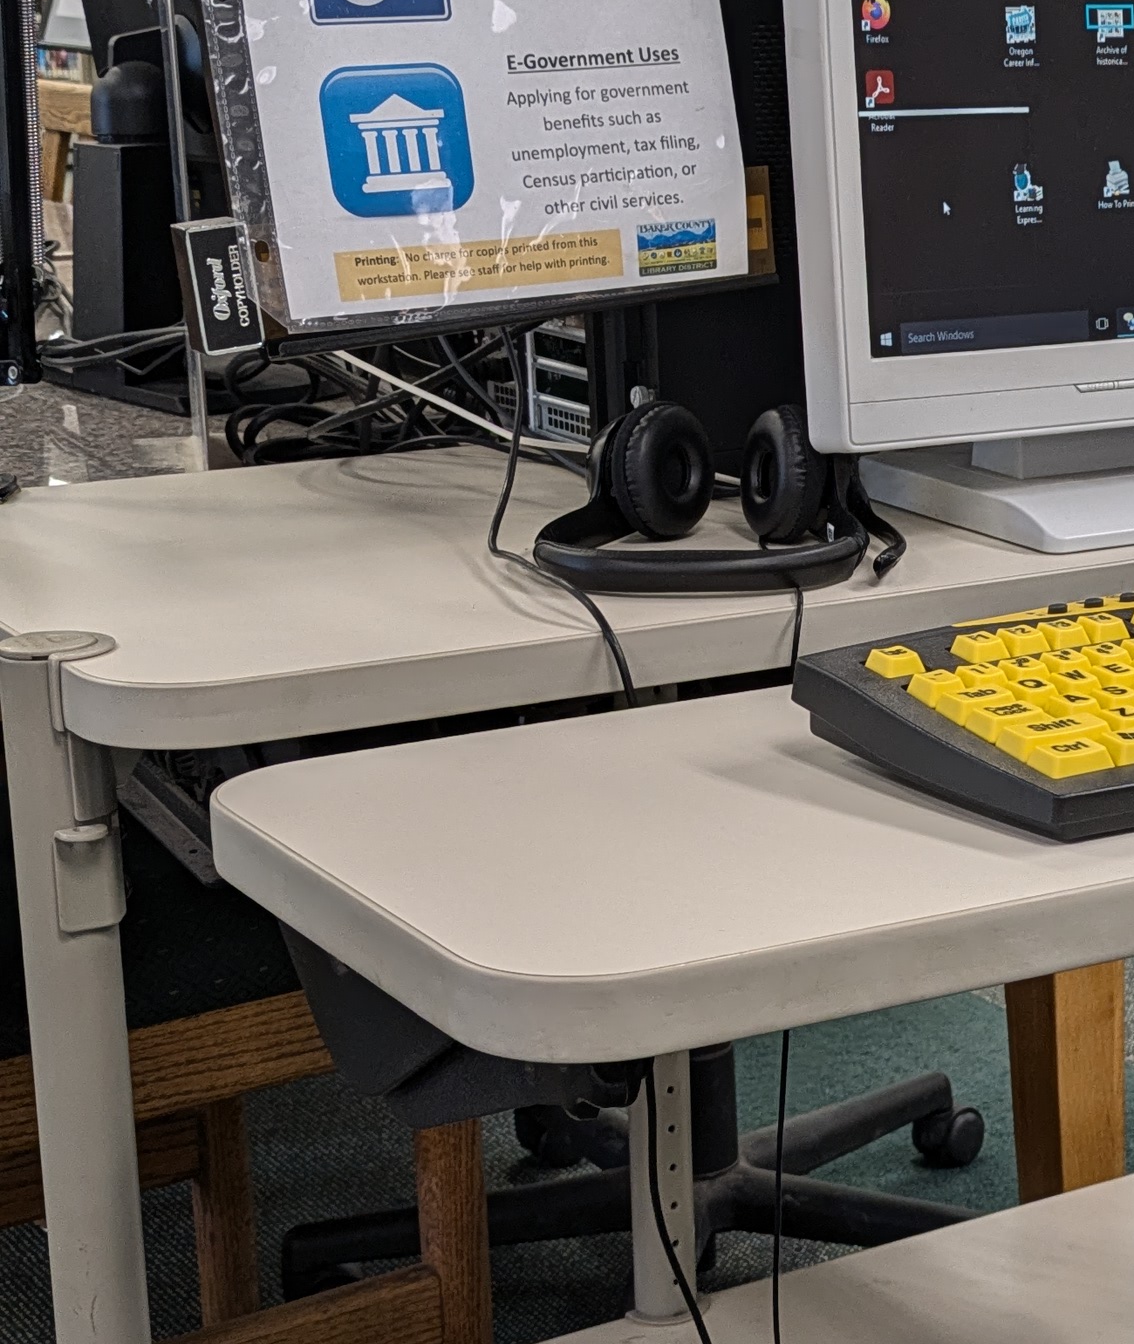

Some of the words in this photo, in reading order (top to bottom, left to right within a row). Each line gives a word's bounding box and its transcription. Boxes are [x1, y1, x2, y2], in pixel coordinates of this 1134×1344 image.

[865, 34, 889, 44] Firefox
[1008, 46, 1033, 57] Oregon
[1096, 45, 1120, 55] Archive
[1120, 44, 1128, 54] of
[506, 48, 634, 71] E-Government
[638, 46, 680, 63] Uses
[1003, 57, 1025, 68] Career
[506, 88, 572, 109] Applying
[575, 86, 596, 101] for
[600, 81, 689, 102] government
[543, 113, 604, 132] benefits
[608, 110, 642, 127] such
[645, 111, 662, 124] as
[870, 122, 895, 133] Reader
[511, 140, 630, 162] unemployment,
[634, 139, 657, 152] tax
[659, 135, 701, 151] filing,
[522, 173, 576, 188] Census
[580, 164, 678, 187] participation,
[681, 162, 697, 176] or
[544, 199, 585, 215] other
[589, 195, 618, 211] civil
[622, 192, 684, 208] services.
[1014, 204, 1043, 215] Learning
[1097, 200, 1114, 210] How
[1114, 199, 1123, 209] To
[639, 223, 676, 234] BAKER
[675, 219, 714, 230] COUNTY
[354, 253, 399, 268] Printing:
[405, 252, 420, 264] No
[421, 249, 456, 263] charge
[458, 247, 475, 258] for
[511, 242, 550, 257] printed
[551, 239, 577, 252] from
[577, 236, 599, 249] this
[357, 271, 422, 288] workstation.
[423, 268, 456, 282] Please
[458, 268, 476, 279] see
[477, 263, 500, 276] staff
[519, 259, 543, 273] help
[544, 257, 567, 270] with
[568, 254, 611, 270] printing.
[641, 265, 677, 276] LIBRARY
[678, 262, 714, 272] DISTRICT
[206, 257, 232, 321] Oxford
[227, 244, 250, 327] COPYHOLDER
[907, 330, 936, 344] Search
[936, 329, 975, 342] Windows
[966, 633, 990, 642] F1
[1005, 627, 1031, 635] F2
[1046, 620, 1072, 628] F3
[1086, 614, 1112, 622] F4
[957, 688, 998, 699] Tab
[1017, 678, 1048, 689] Q
[1057, 669, 1088, 681] W
[1101, 663, 1131, 674] E
[1062, 694, 1091, 703] A
[1101, 686, 1128, 695] S
[983, 702, 1023, 712] Caps
[995, 705, 1033, 717] Lock
[1027, 718, 1082, 732] Shift
[1050, 740, 1091, 753] Ctrl
